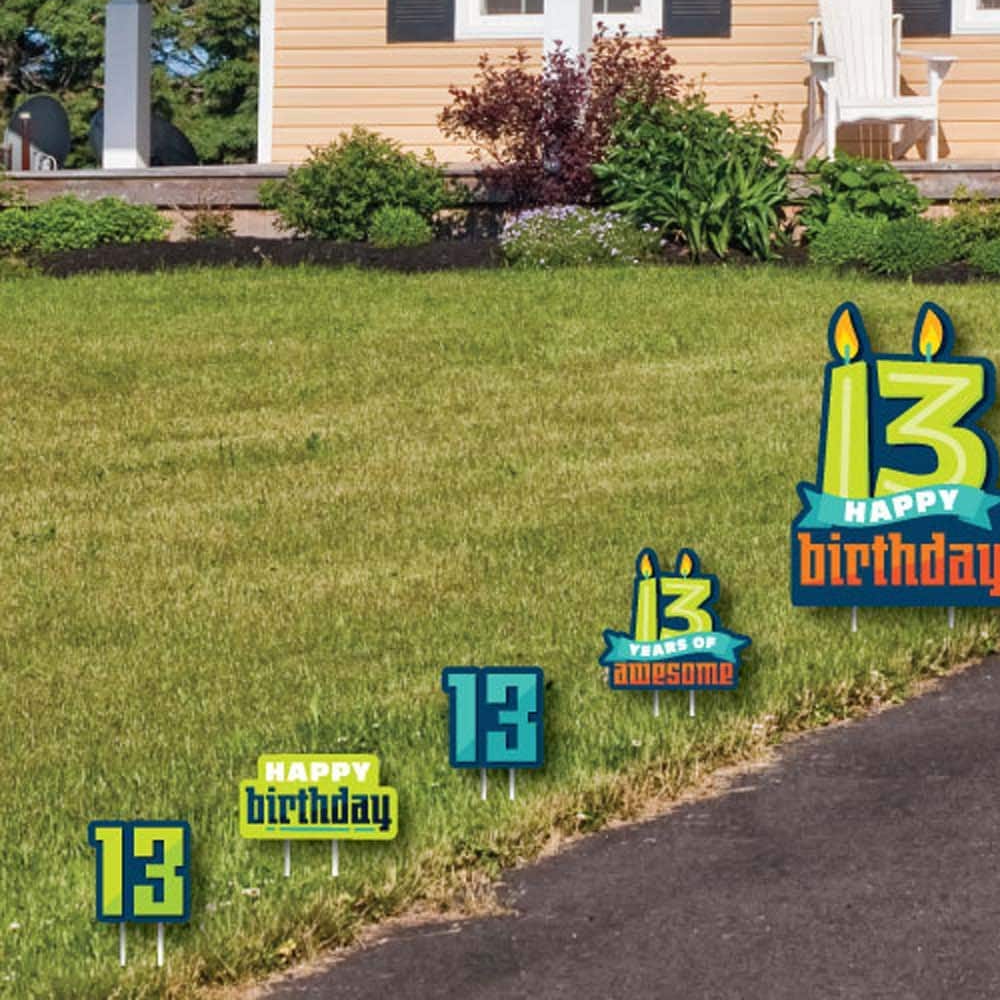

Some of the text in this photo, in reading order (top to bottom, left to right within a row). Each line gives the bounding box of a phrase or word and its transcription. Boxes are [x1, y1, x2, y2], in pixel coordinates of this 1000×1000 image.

[820, 360, 987, 500] 13
[844, 489, 959, 523] HAPPY
[635, 577, 713, 642] 13
[629, 636, 717, 657] YEARS OF
[613, 662, 734, 685] awesome
[448, 673, 537, 763] 13
[265, 761, 371, 782] HAPPY
[245, 786, 393, 831] birthday
[95, 827, 184, 916] 13
